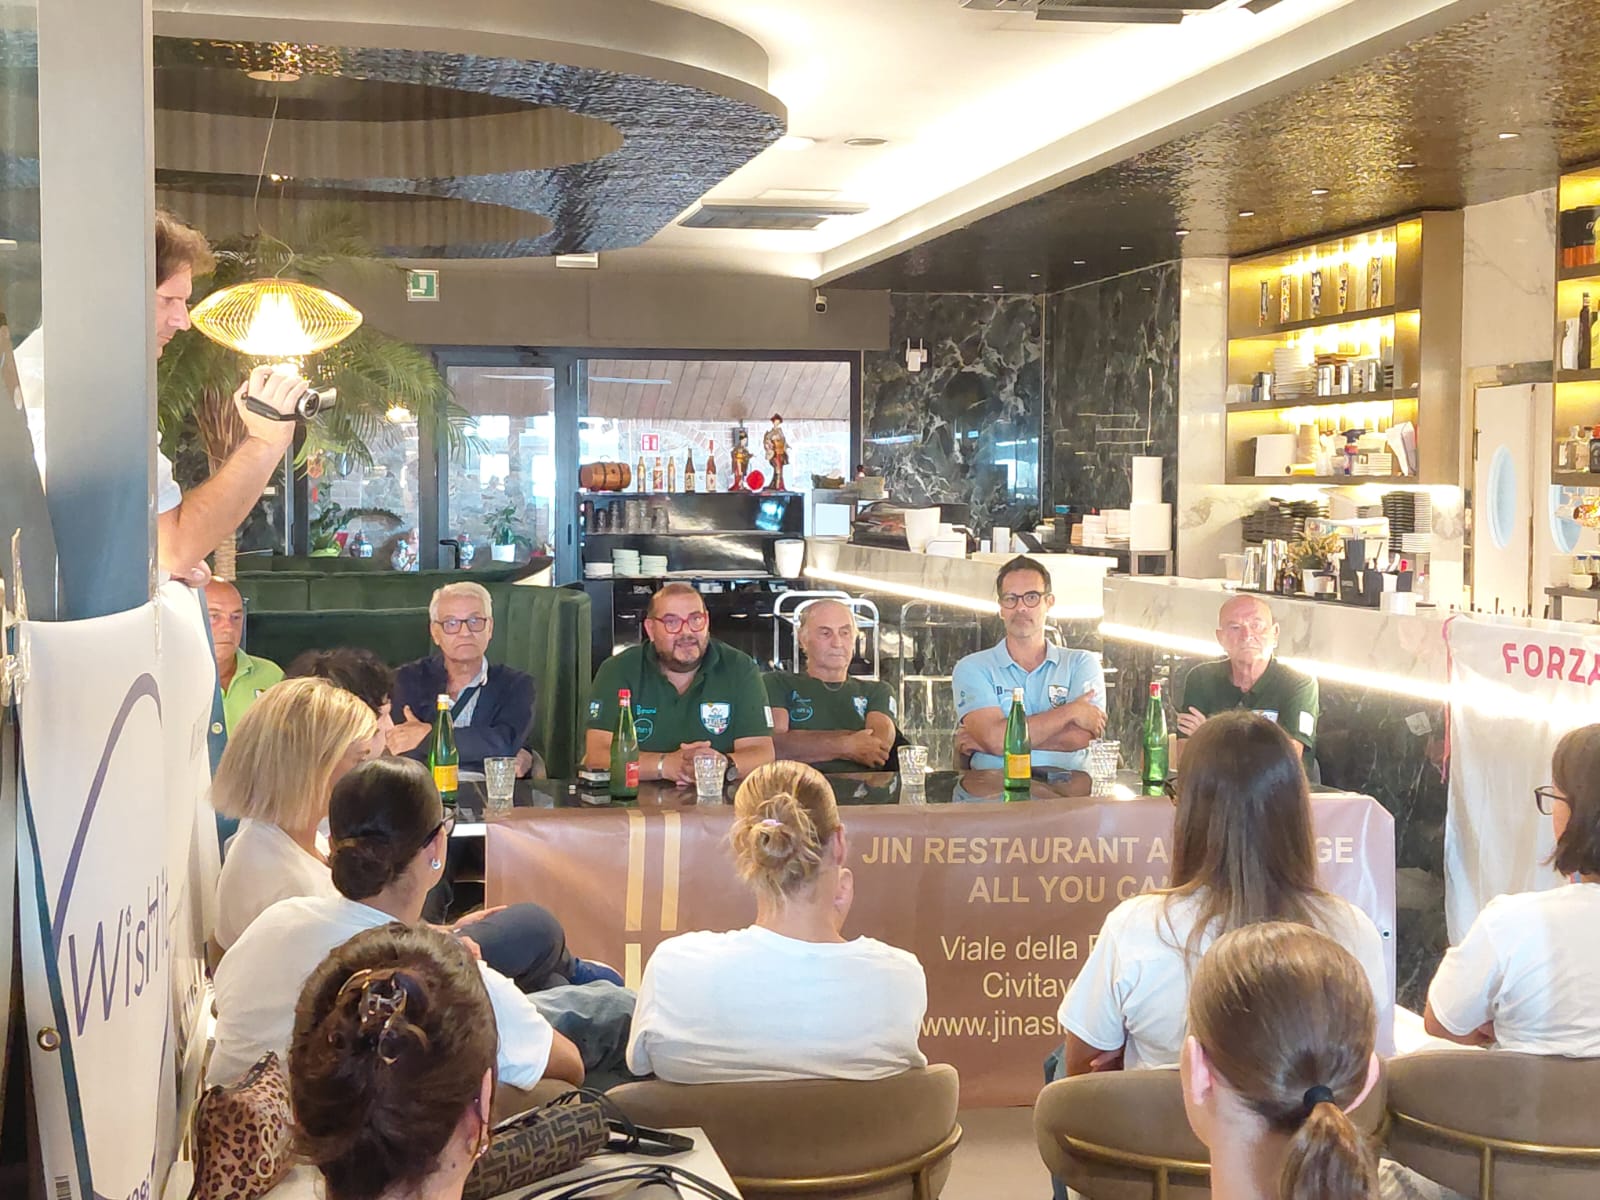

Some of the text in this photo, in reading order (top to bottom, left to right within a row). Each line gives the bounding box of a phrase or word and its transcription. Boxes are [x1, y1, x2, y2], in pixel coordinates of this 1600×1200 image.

[861, 836, 1354, 864] JIN RESTAURANT A GE
[967, 875, 1169, 904] ALL YOU CA
[940, 935, 1007, 961] Viale
[1015, 934, 1078, 961] della
[982, 971, 1074, 998] Civitav
